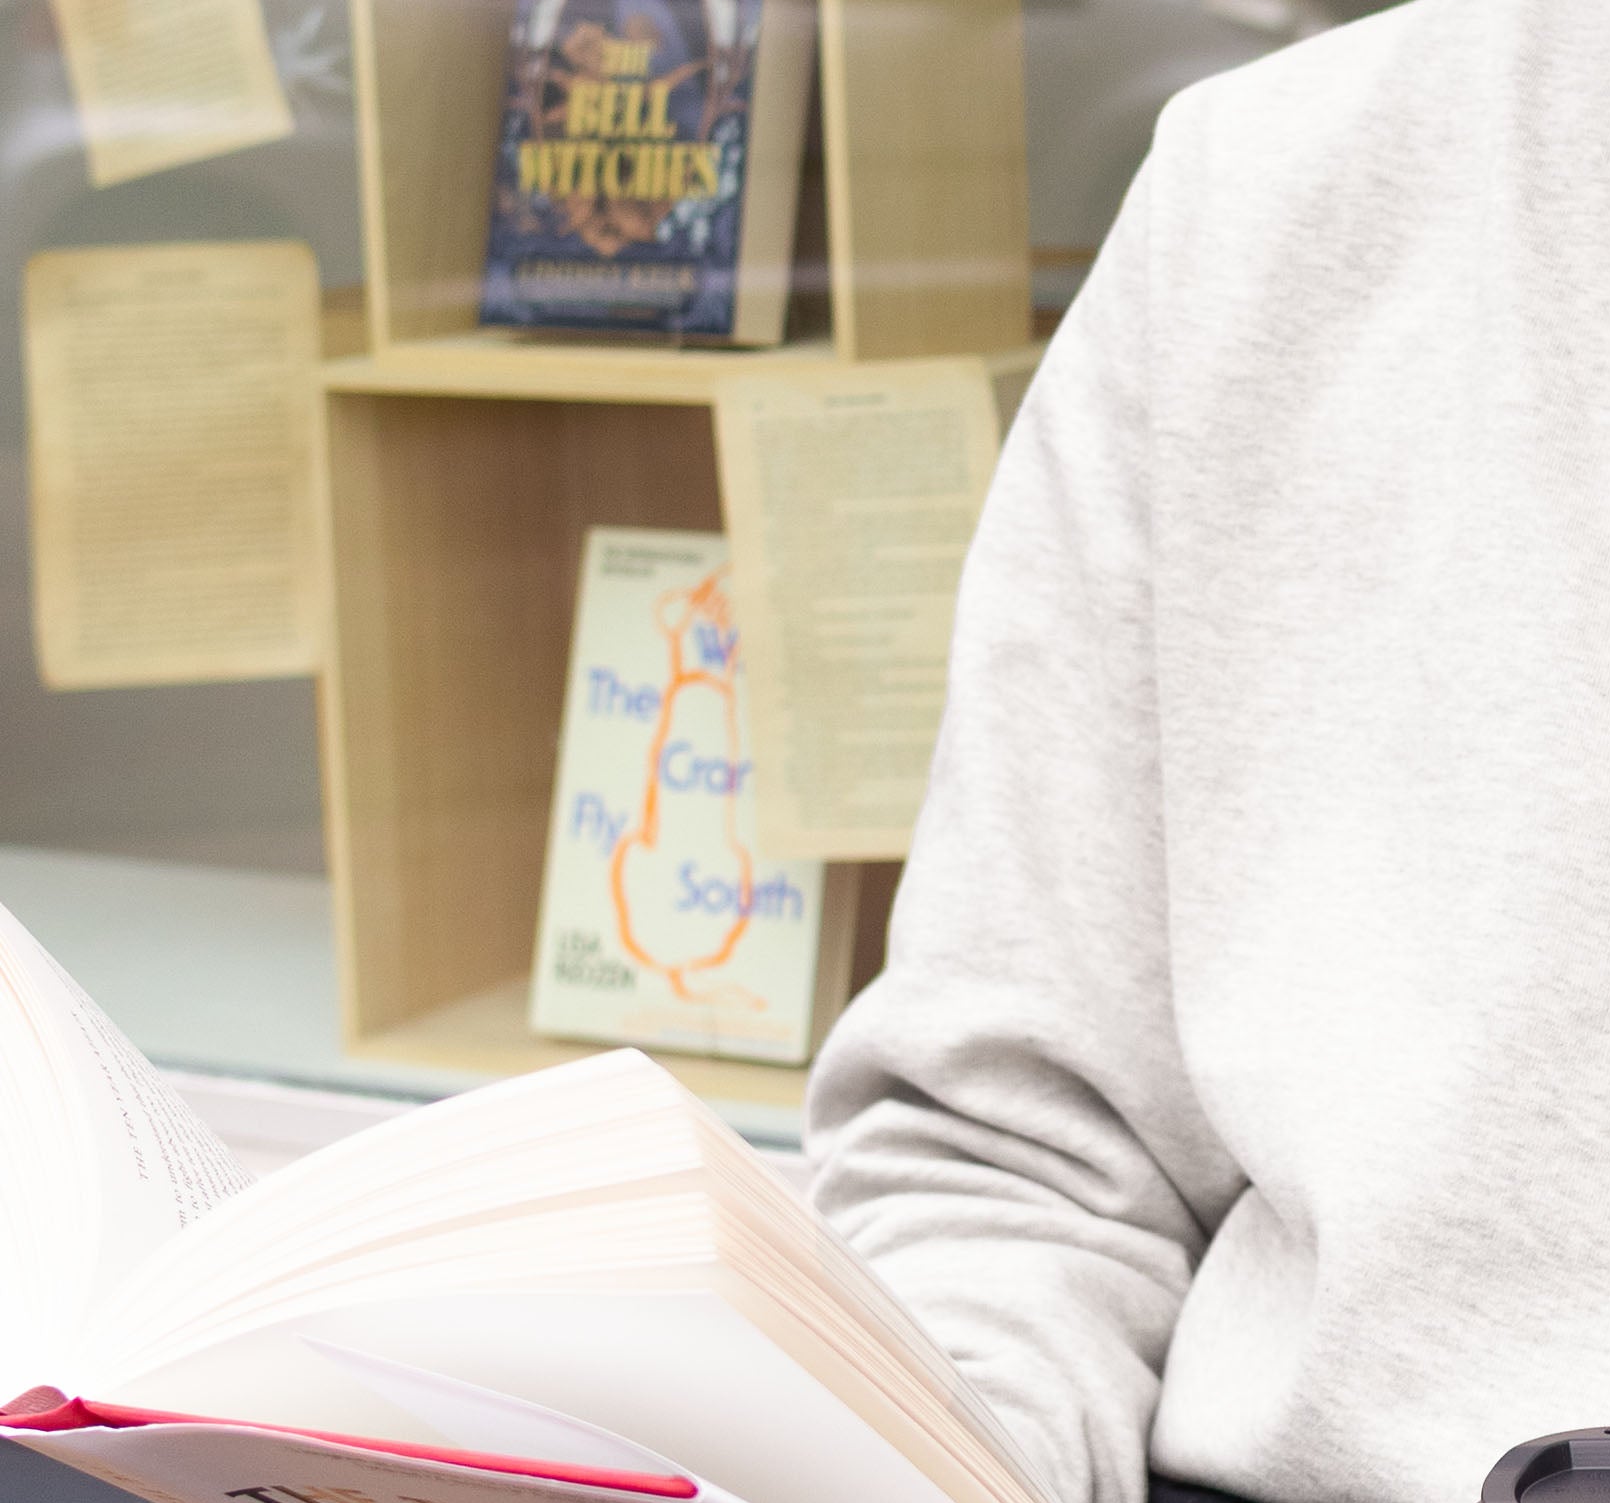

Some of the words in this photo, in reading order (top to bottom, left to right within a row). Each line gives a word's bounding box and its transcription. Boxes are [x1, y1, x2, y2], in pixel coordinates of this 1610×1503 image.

[518, 141, 723, 203] WITCHES
[588, 666, 660, 722] The
[570, 792, 630, 858] Fly
[674, 861, 804, 922] South
